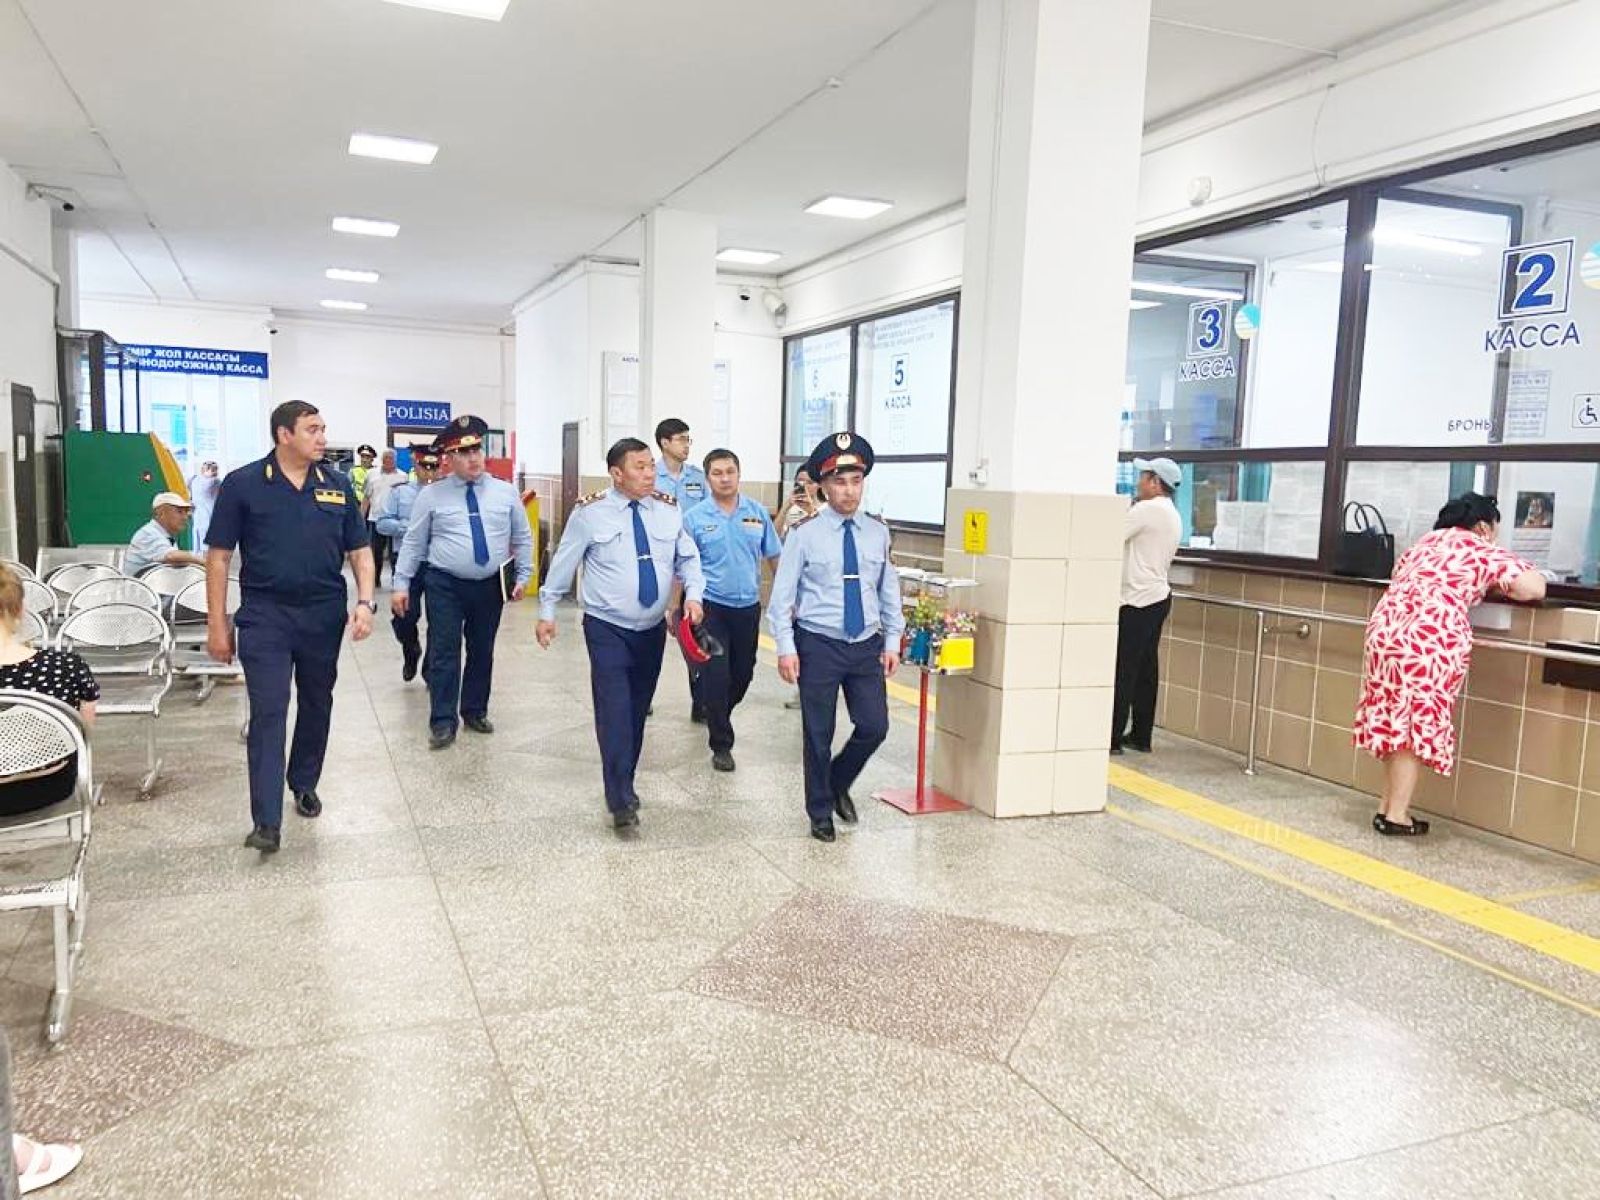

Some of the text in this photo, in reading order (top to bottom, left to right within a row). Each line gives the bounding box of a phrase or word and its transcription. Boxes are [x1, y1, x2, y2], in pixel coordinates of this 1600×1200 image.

[1513, 252, 1556, 309] 2
[1199, 307, 1222, 349] 3
[1484, 321, 1581, 352] КАССА
[154, 349, 182, 359] ЖОЛ
[185, 351, 240, 362] КАССАСЫ
[226, 363, 263, 375] КАССА
[894, 359, 905, 387] 5
[1179, 356, 1236, 382] КАССА
[388, 405, 449, 421] POLISIA
[884, 395, 912, 410] КАССА
[1448, 418, 1493, 431] БРОНЬ
